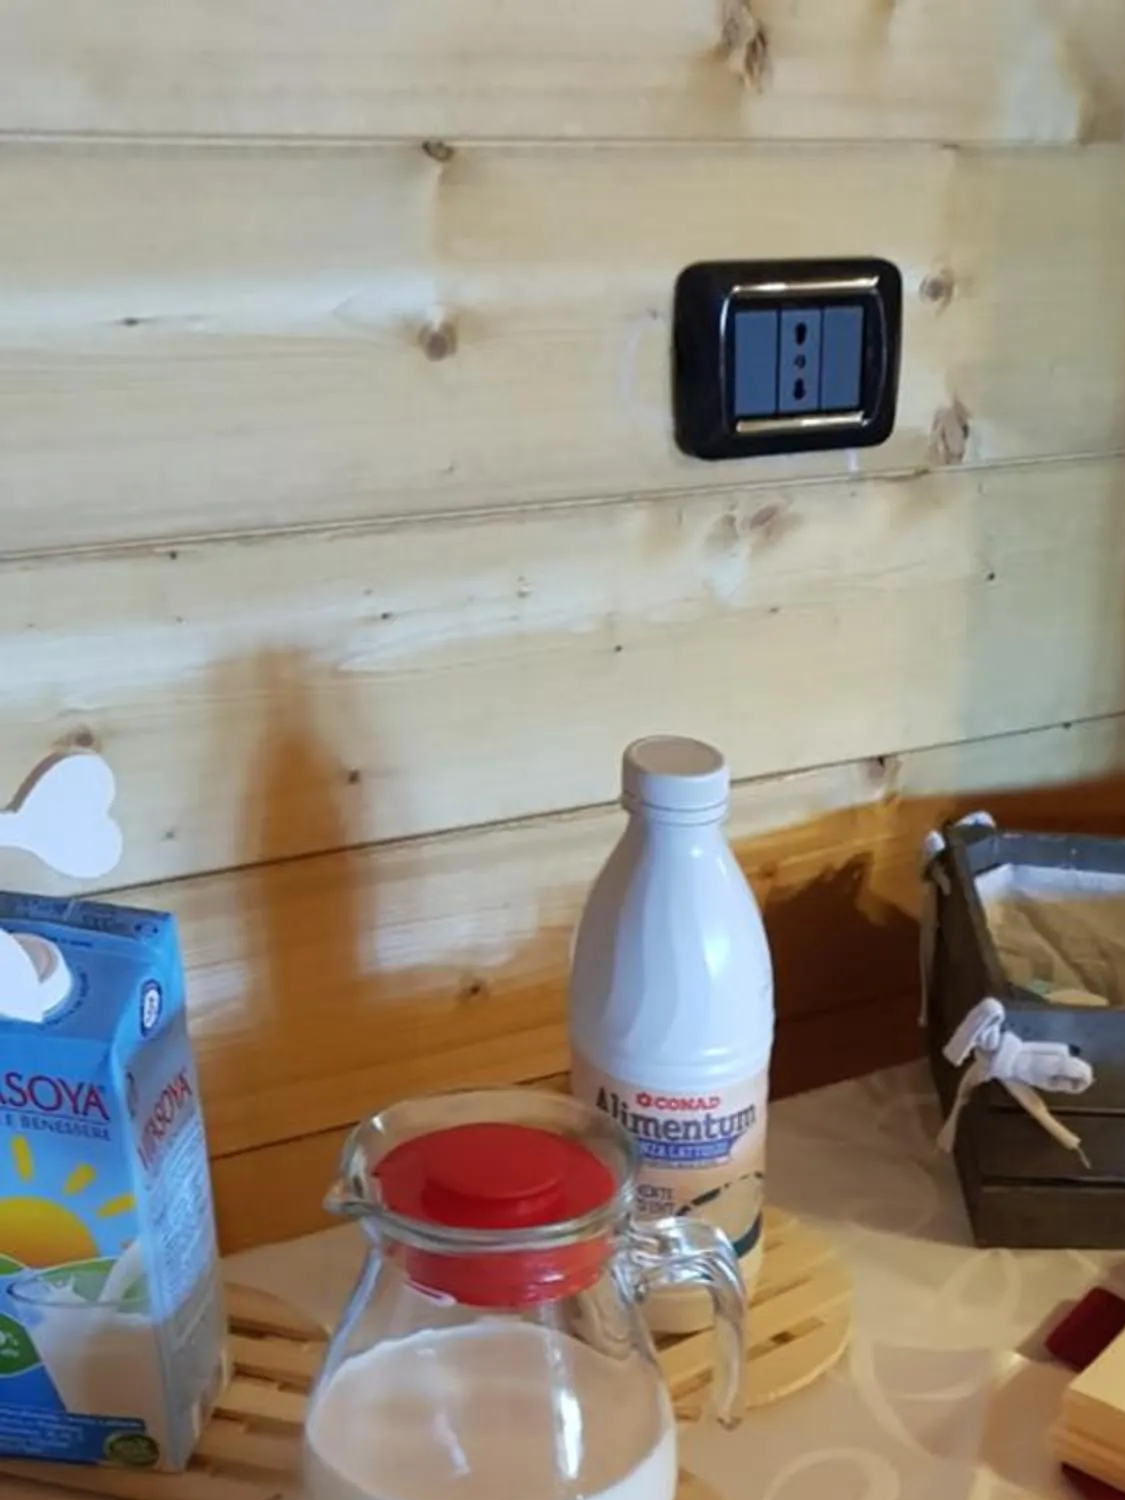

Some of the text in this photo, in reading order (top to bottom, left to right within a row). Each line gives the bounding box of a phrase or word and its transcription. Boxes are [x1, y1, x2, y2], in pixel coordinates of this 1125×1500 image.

[0, 1071, 110, 1122] SOYA
[596, 1086, 757, 1141] Alimentum
[655, 1096, 720, 1111] CONAD
